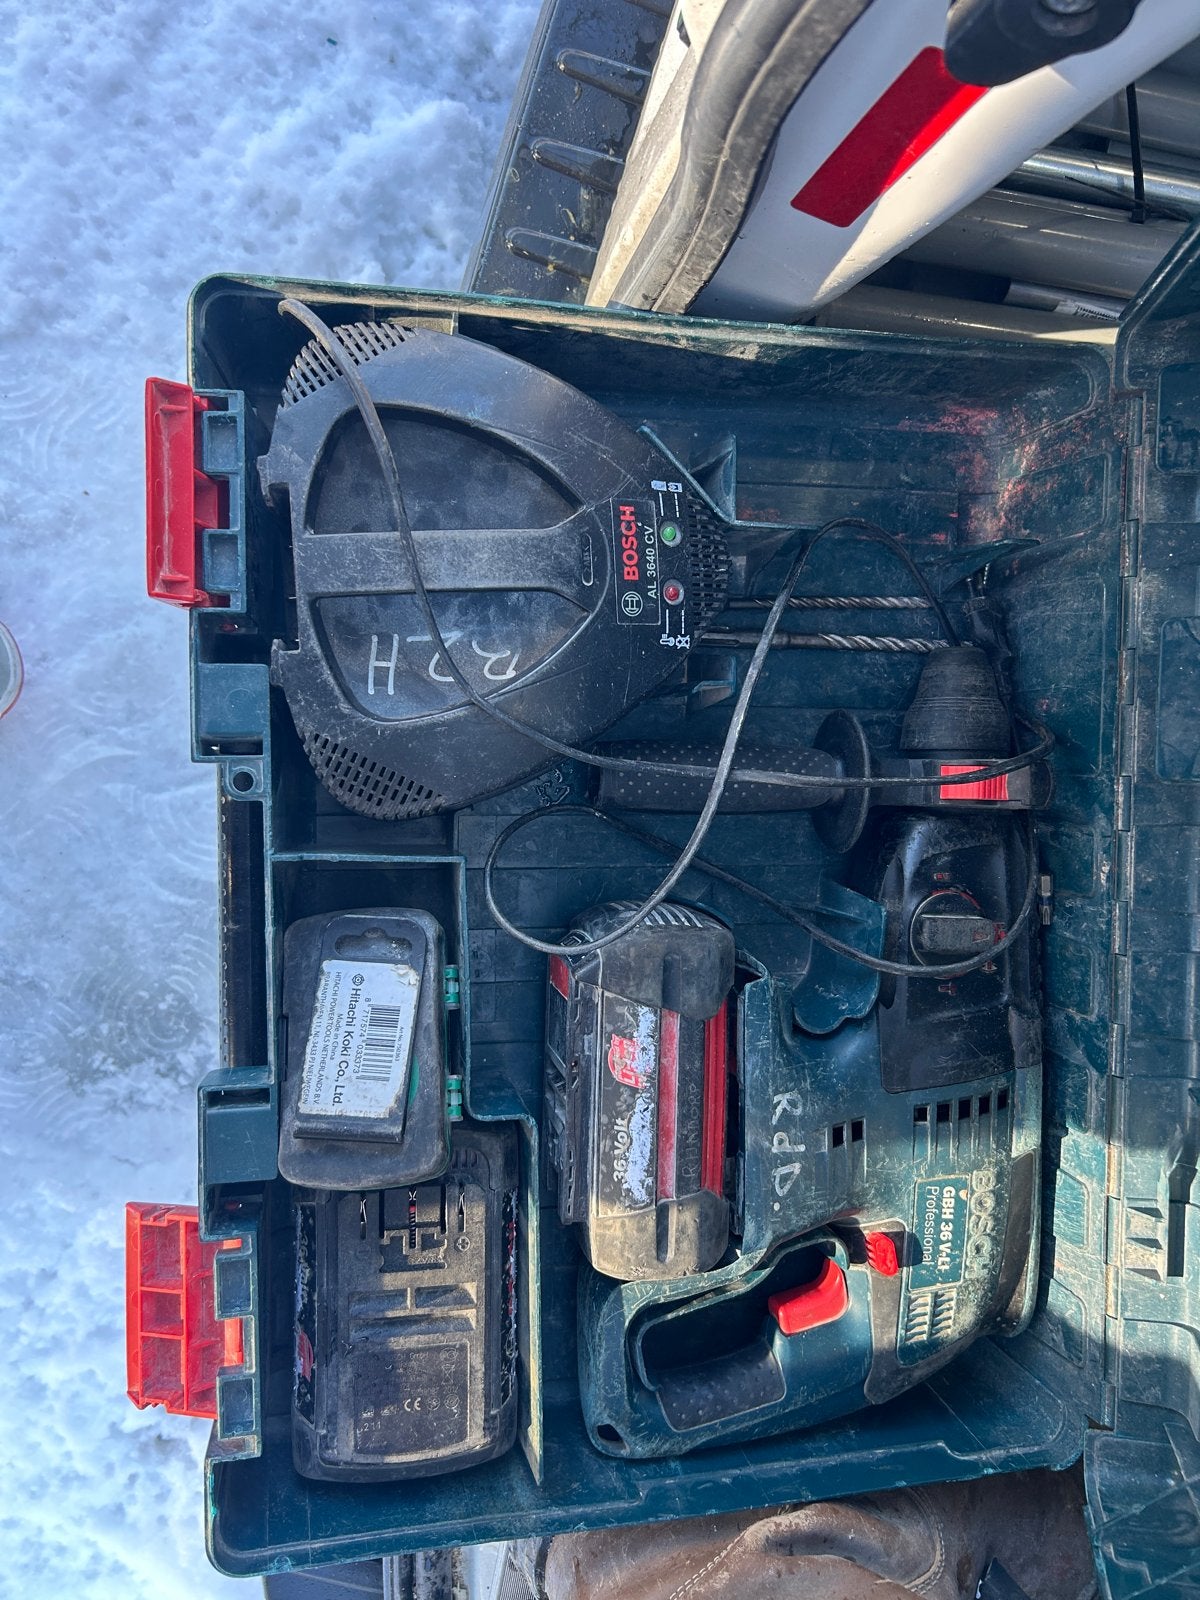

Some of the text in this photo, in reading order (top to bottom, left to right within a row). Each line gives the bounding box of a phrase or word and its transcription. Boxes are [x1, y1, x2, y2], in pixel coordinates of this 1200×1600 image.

[619, 505, 639, 581] BOSCH
[644, 525, 658, 599] AL 3640 CV
[331, 971, 342, 997] HITACHI
[334, 1013, 343, 1032] Made
[359, 1009, 370, 1037] 717574
[330, 1041, 341, 1060] China
[332, 988, 362, 1106] Hitachi Koki Co., Ltd.
[353, 1044, 365, 1074] 033373
[314, 1044, 331, 1092] NETHERLANDS
[613, 1118, 628, 1182] 36 Volt
[941, 1186, 955, 1219] GBH
[922, 1185, 939, 1266] Professional
[939, 1222, 952, 1241] 36
[965, 1169, 996, 1279] BOSCH
